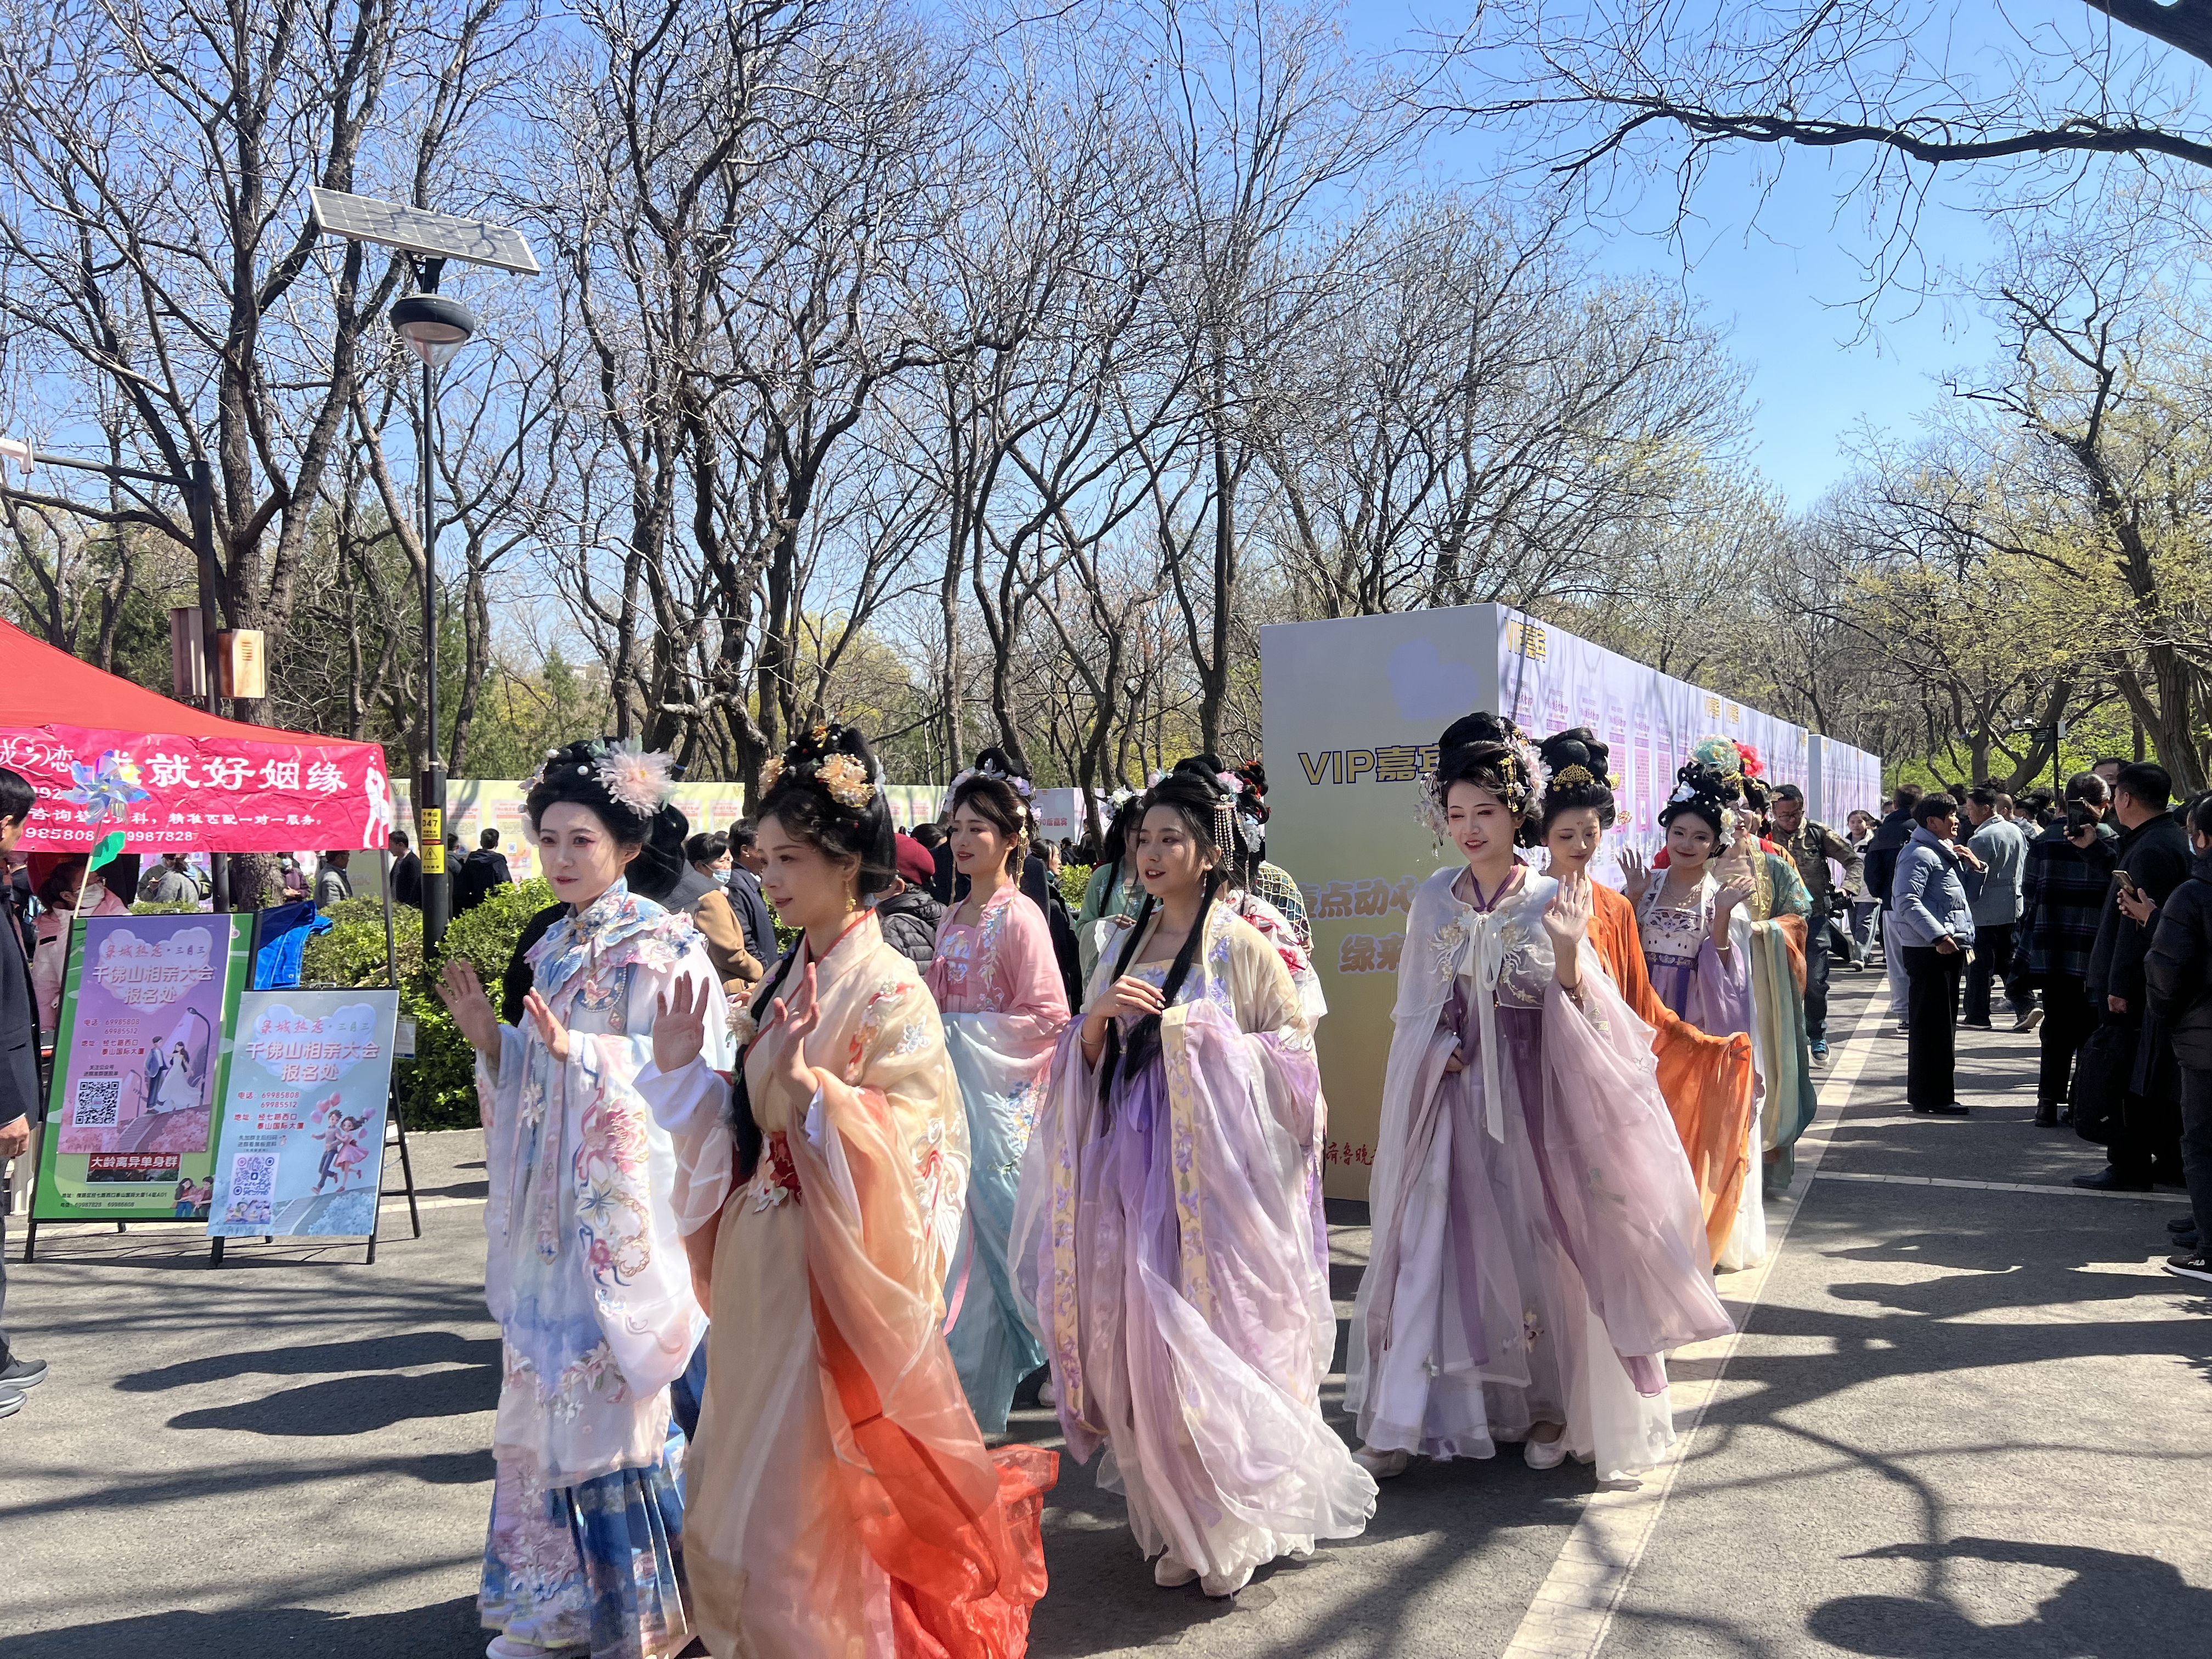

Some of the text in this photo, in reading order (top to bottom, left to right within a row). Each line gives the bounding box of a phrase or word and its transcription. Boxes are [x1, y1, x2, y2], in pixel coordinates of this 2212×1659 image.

[1504, 617, 1547, 663] VIP嘉宾
[391, 783, 410, 795] VI
[1040, 817, 1068, 826] 0后嘉宾
[92, 964, 215, 983] 千佛山相亲大会
[123, 988, 177, 1005] 报名处
[246, 1041, 380, 1060] 千佛山相亲大会
[281, 1063, 339, 1082] 报名处
[91, 1156, 178, 1167] 大龄离异单身群
[1327, 1142, 1377, 1166] 齐鲁晚
